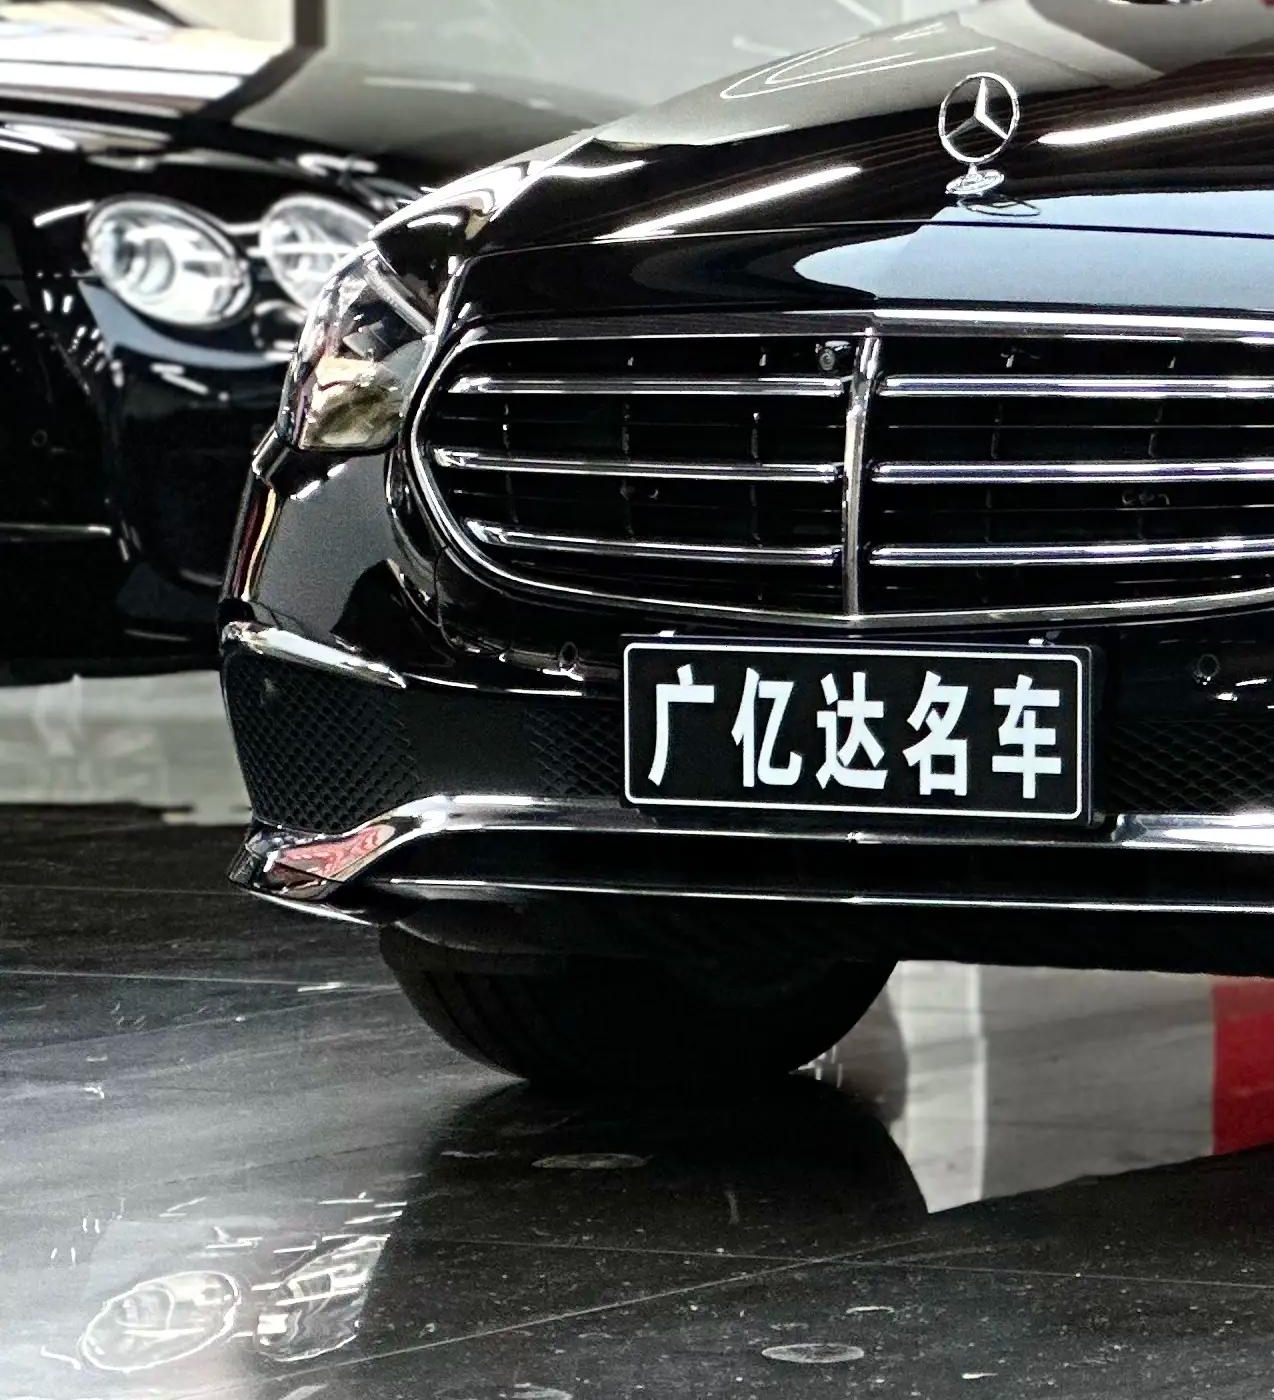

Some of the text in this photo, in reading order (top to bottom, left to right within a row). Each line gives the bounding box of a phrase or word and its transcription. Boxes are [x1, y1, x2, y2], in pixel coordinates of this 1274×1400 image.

[647, 663, 1063, 799] 广亿达名车
